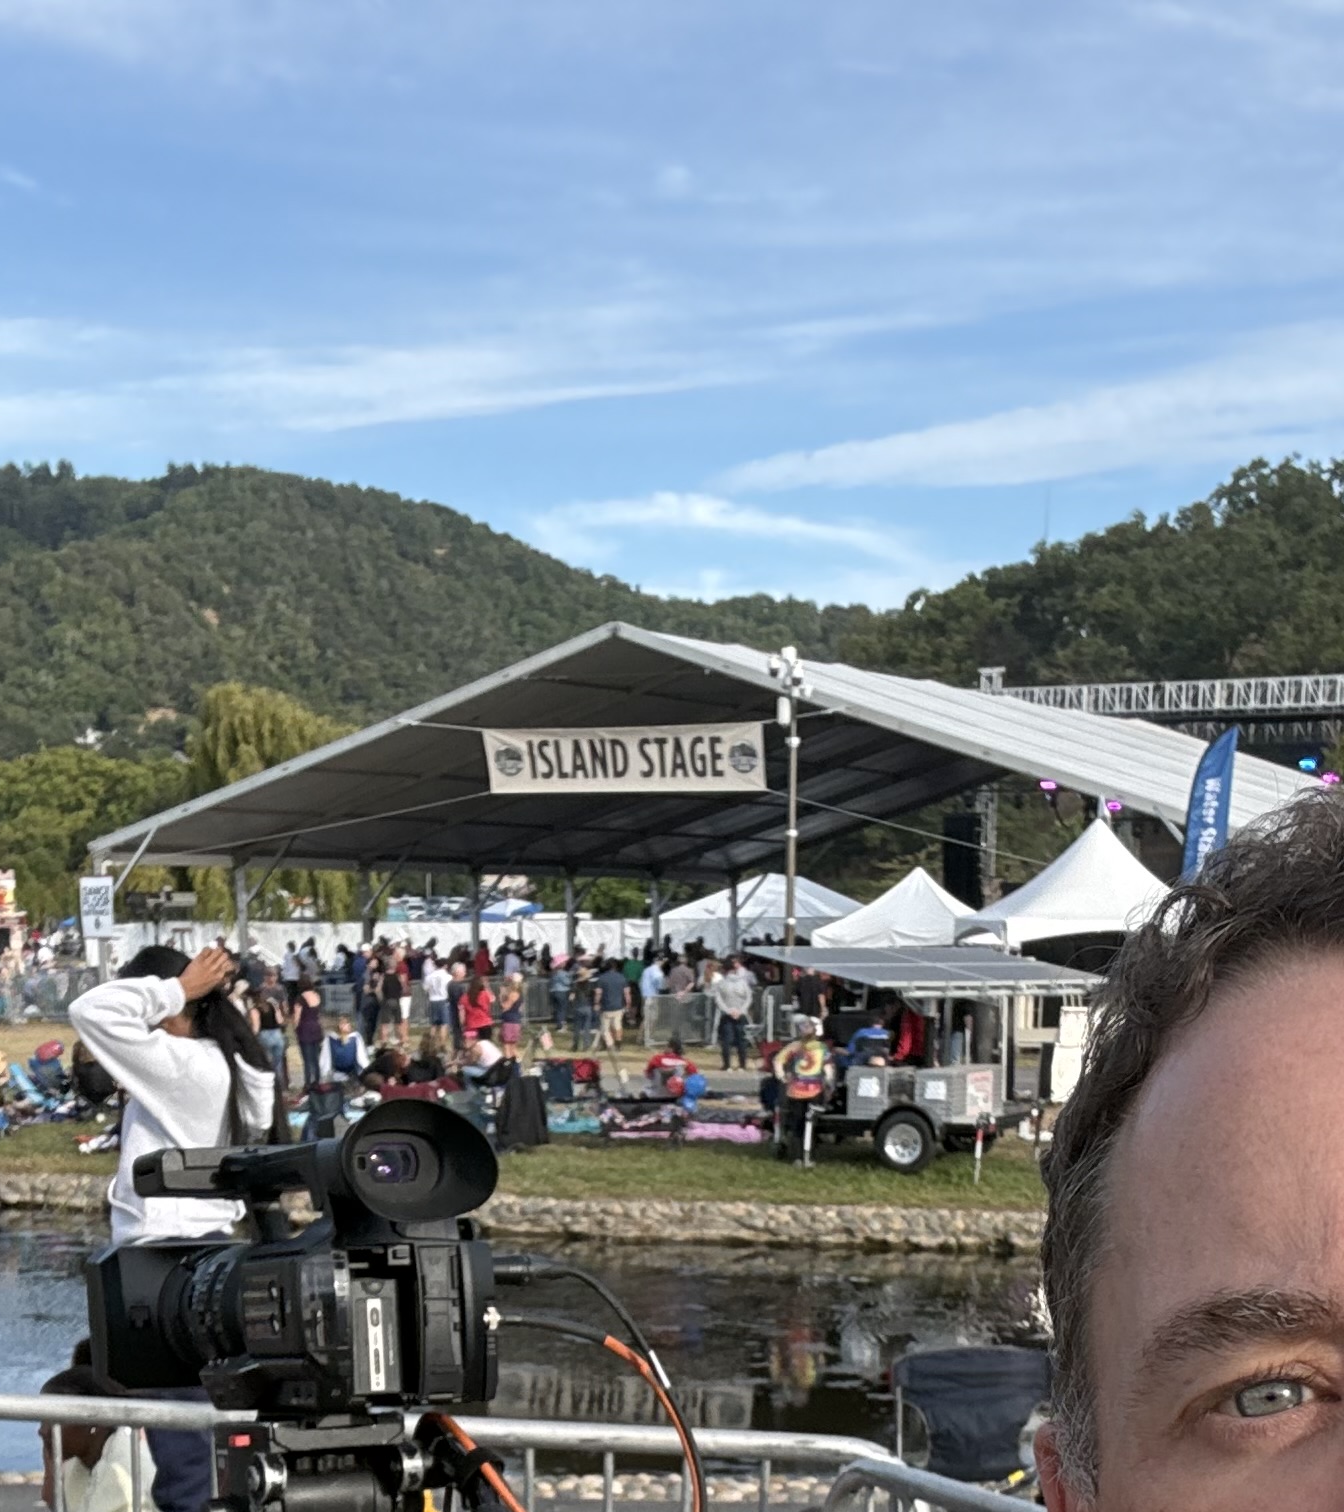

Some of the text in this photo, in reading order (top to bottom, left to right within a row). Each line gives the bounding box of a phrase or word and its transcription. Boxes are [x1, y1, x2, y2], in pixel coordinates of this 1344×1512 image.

[526, 735, 725, 780] ISLAND STAGE
[1202, 777, 1222, 824] Water
